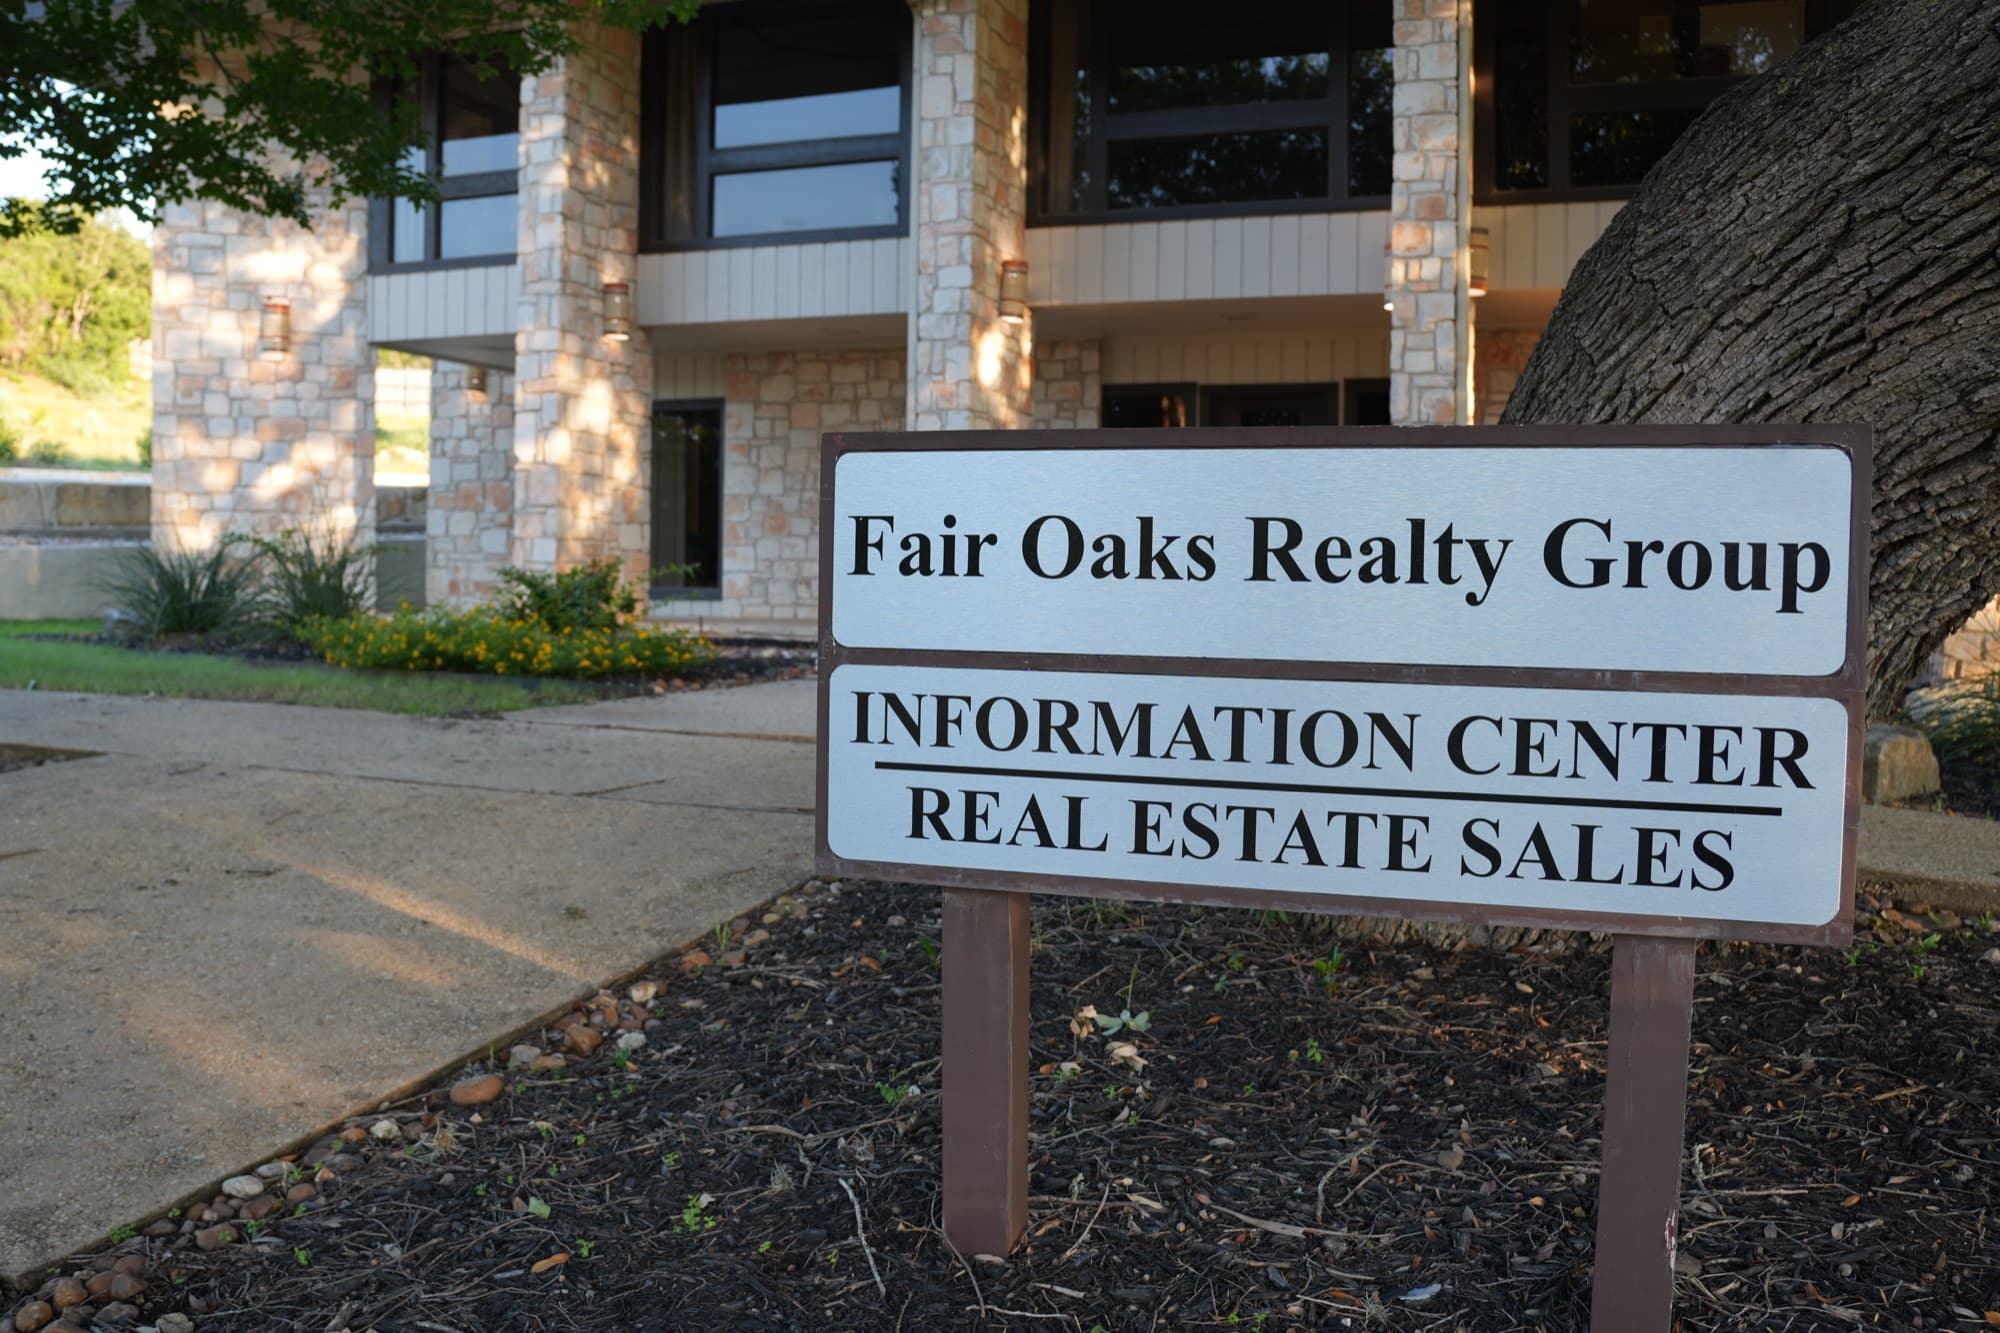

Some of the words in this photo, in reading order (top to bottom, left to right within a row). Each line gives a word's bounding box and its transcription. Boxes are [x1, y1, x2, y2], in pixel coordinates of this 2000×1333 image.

[847, 515, 998, 577] Fair
[1021, 515, 1216, 583] Oaks
[1242, 516, 1514, 607] Realty
[1543, 517, 1831, 614] Group
[850, 691, 1422, 773] INFORMATION
[1446, 715, 1817, 790] CENTER
[905, 786, 1109, 852] REAL
[1127, 799, 1433, 873] ESTATE
[1460, 817, 1735, 892] SALES
